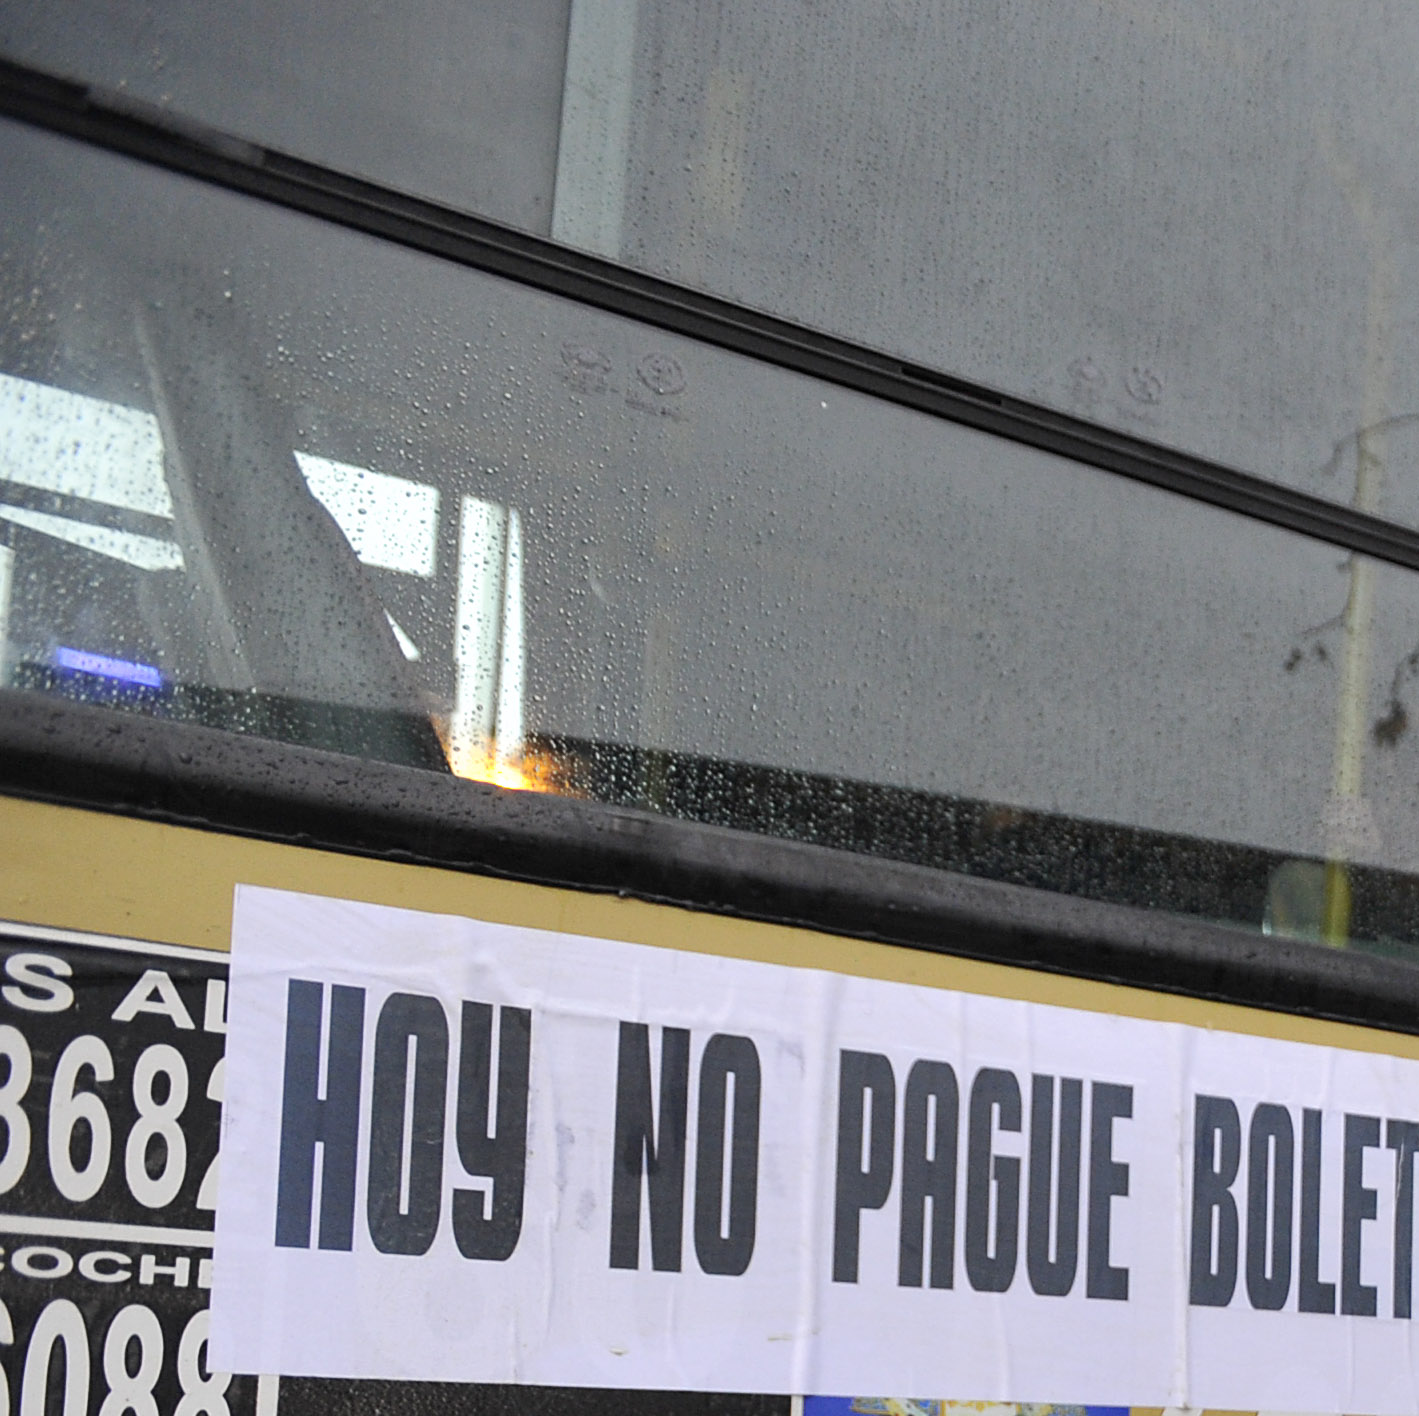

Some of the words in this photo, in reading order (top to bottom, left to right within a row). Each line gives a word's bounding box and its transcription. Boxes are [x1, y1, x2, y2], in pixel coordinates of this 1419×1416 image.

[274, 978, 533, 1261] HOY
[609, 1020, 763, 1277] NO
[831, 1048, 1134, 1302] PAGUE
